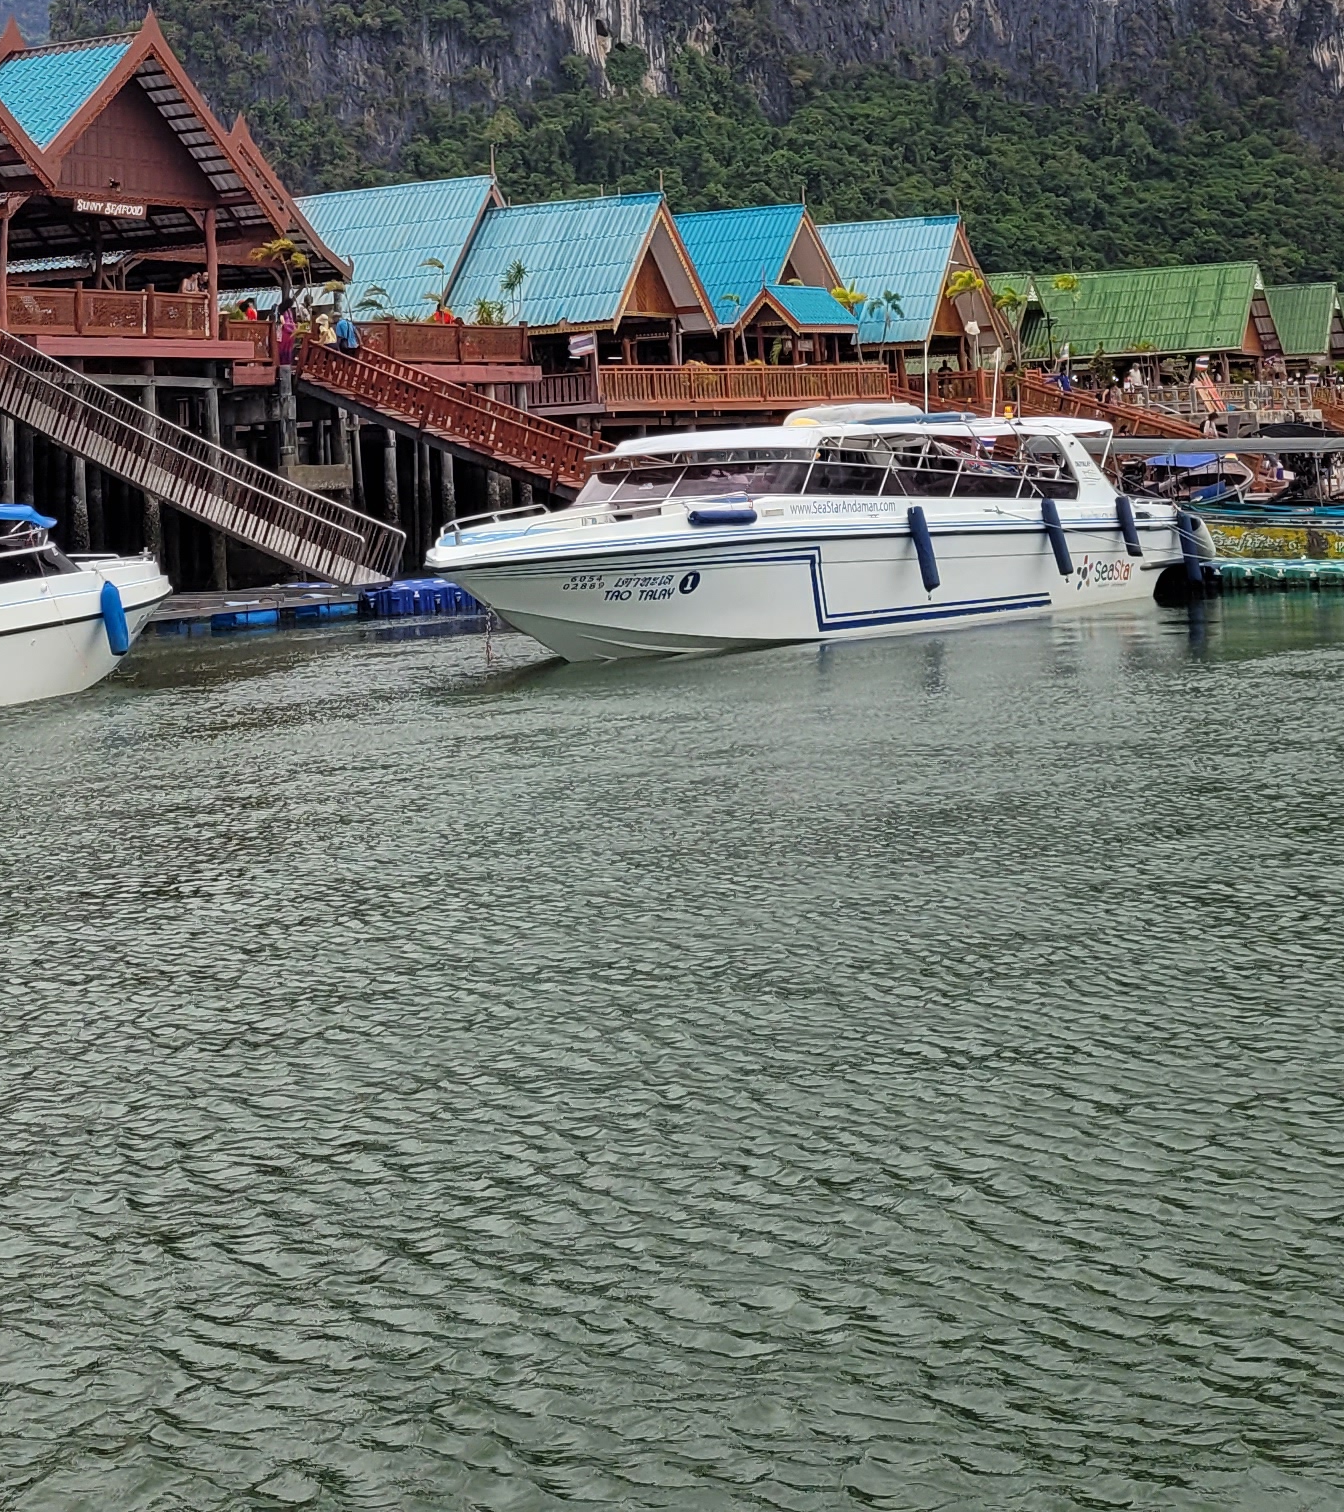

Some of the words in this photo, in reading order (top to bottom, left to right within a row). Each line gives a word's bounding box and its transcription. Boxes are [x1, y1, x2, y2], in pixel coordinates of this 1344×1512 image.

[76, 198, 104, 212] SUNNY
[104, 201, 144, 216] SEAFOOD
[790, 499, 896, 515] www.SeaStarAndaman.com
[1094, 558, 1135, 583] SeaStar
[604, 590, 632, 601] TAO
[638, 588, 675, 602] TALAY
